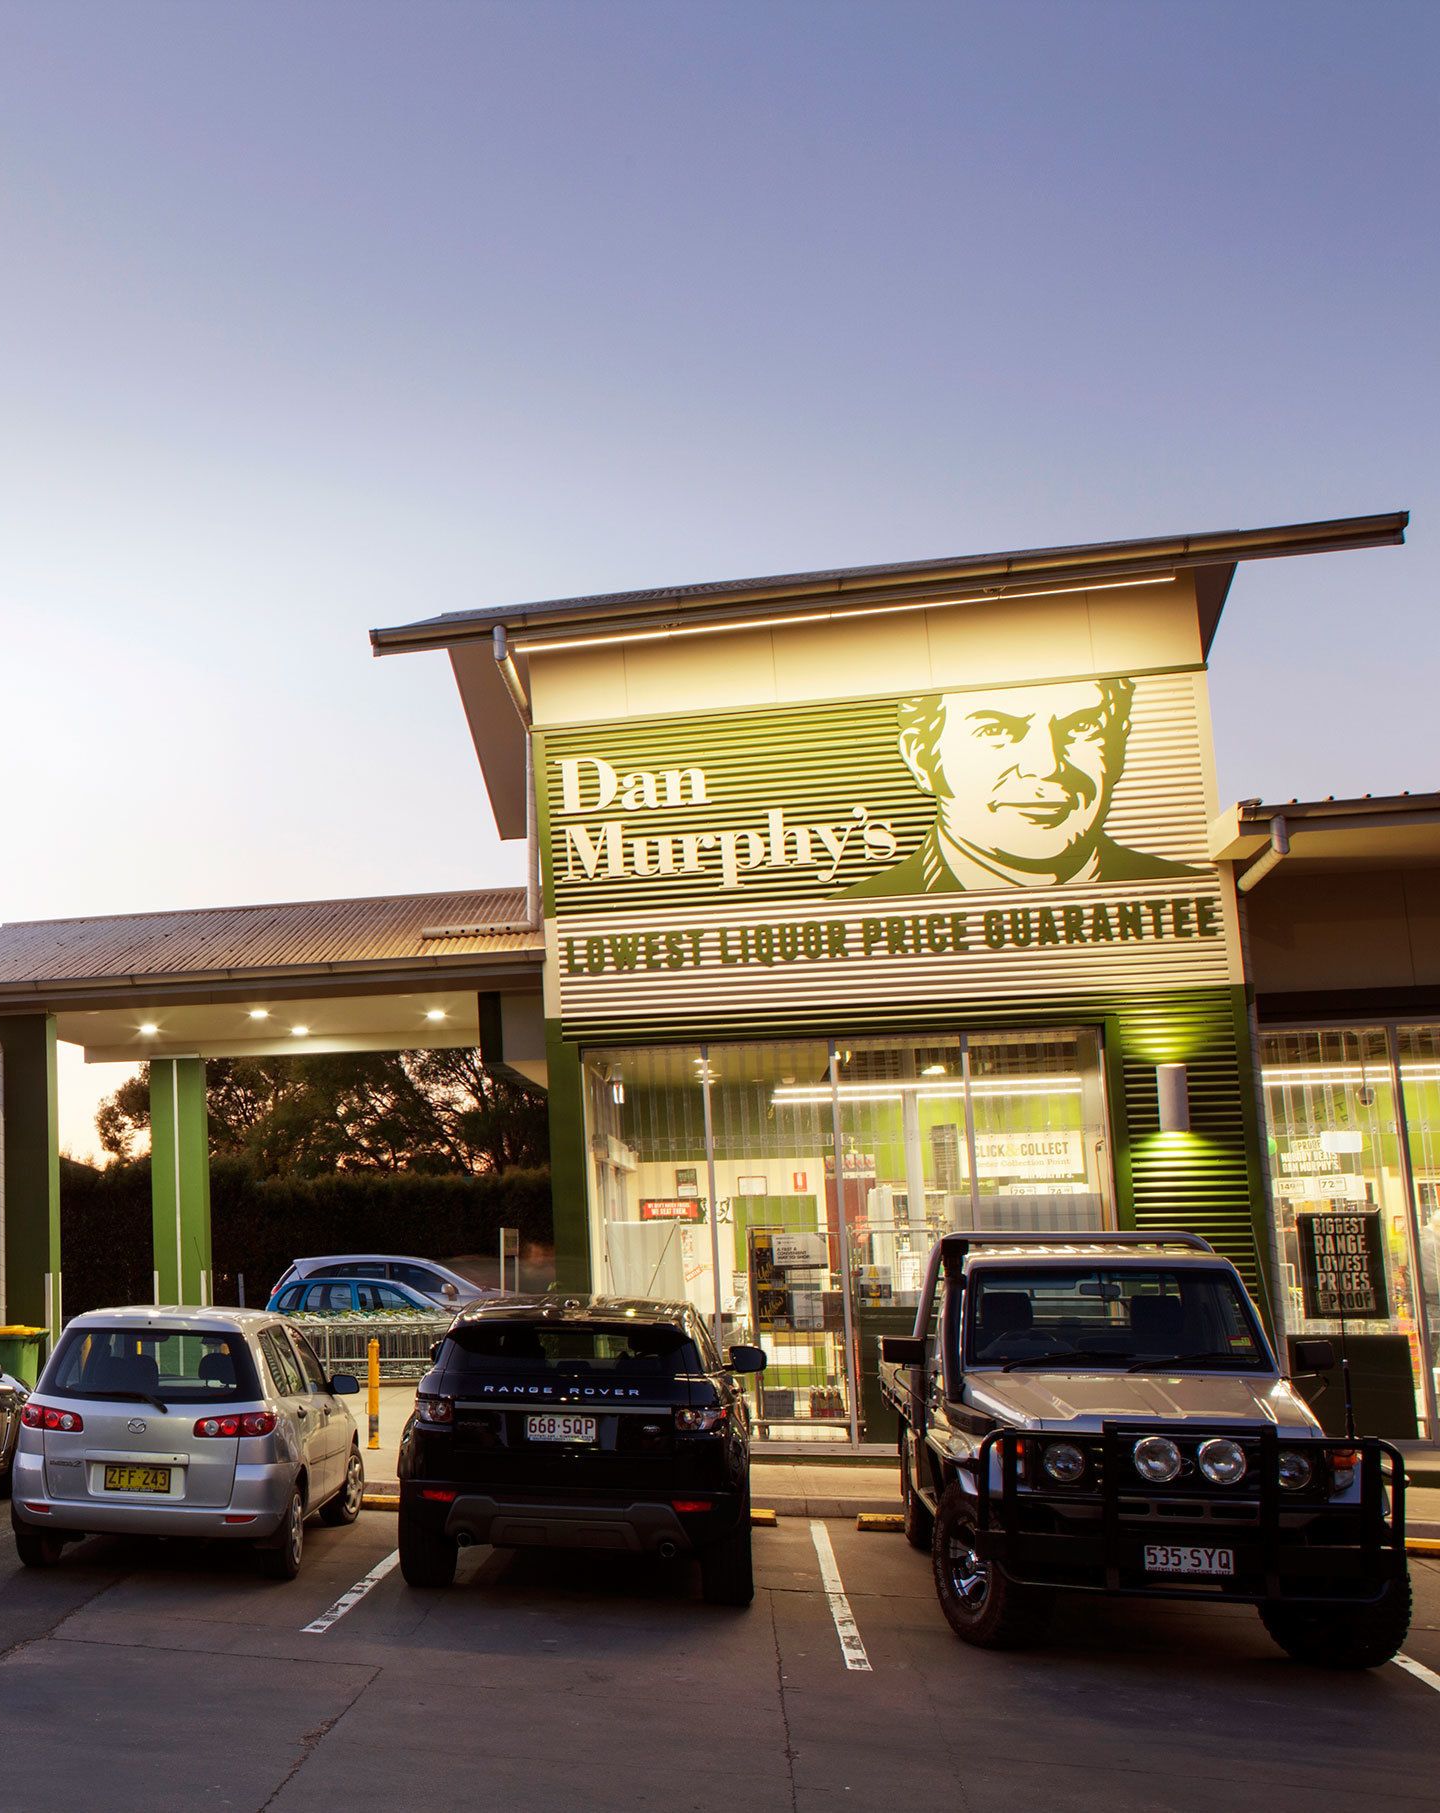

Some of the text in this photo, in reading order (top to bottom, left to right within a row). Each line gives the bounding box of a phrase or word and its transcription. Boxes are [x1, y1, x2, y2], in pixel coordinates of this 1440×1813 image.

[555, 757, 712, 815] Dan
[560, 806, 897, 890] Murphy's
[566, 896, 1222, 974] LOWEST LIQUOR PRICE GUARANTEE
[975, 1144, 1006, 1158] CLICK
[1020, 1141, 1069, 1156] COLLECT
[1312, 1217, 1366, 1234] BIGGEST
[1314, 1234, 1370, 1254] RANGE.
[1316, 1255, 1368, 1271] LOWEST
[1328, 1291, 1372, 1310] PROOF
[484, 1384, 641, 1396] RANGE ROVER
